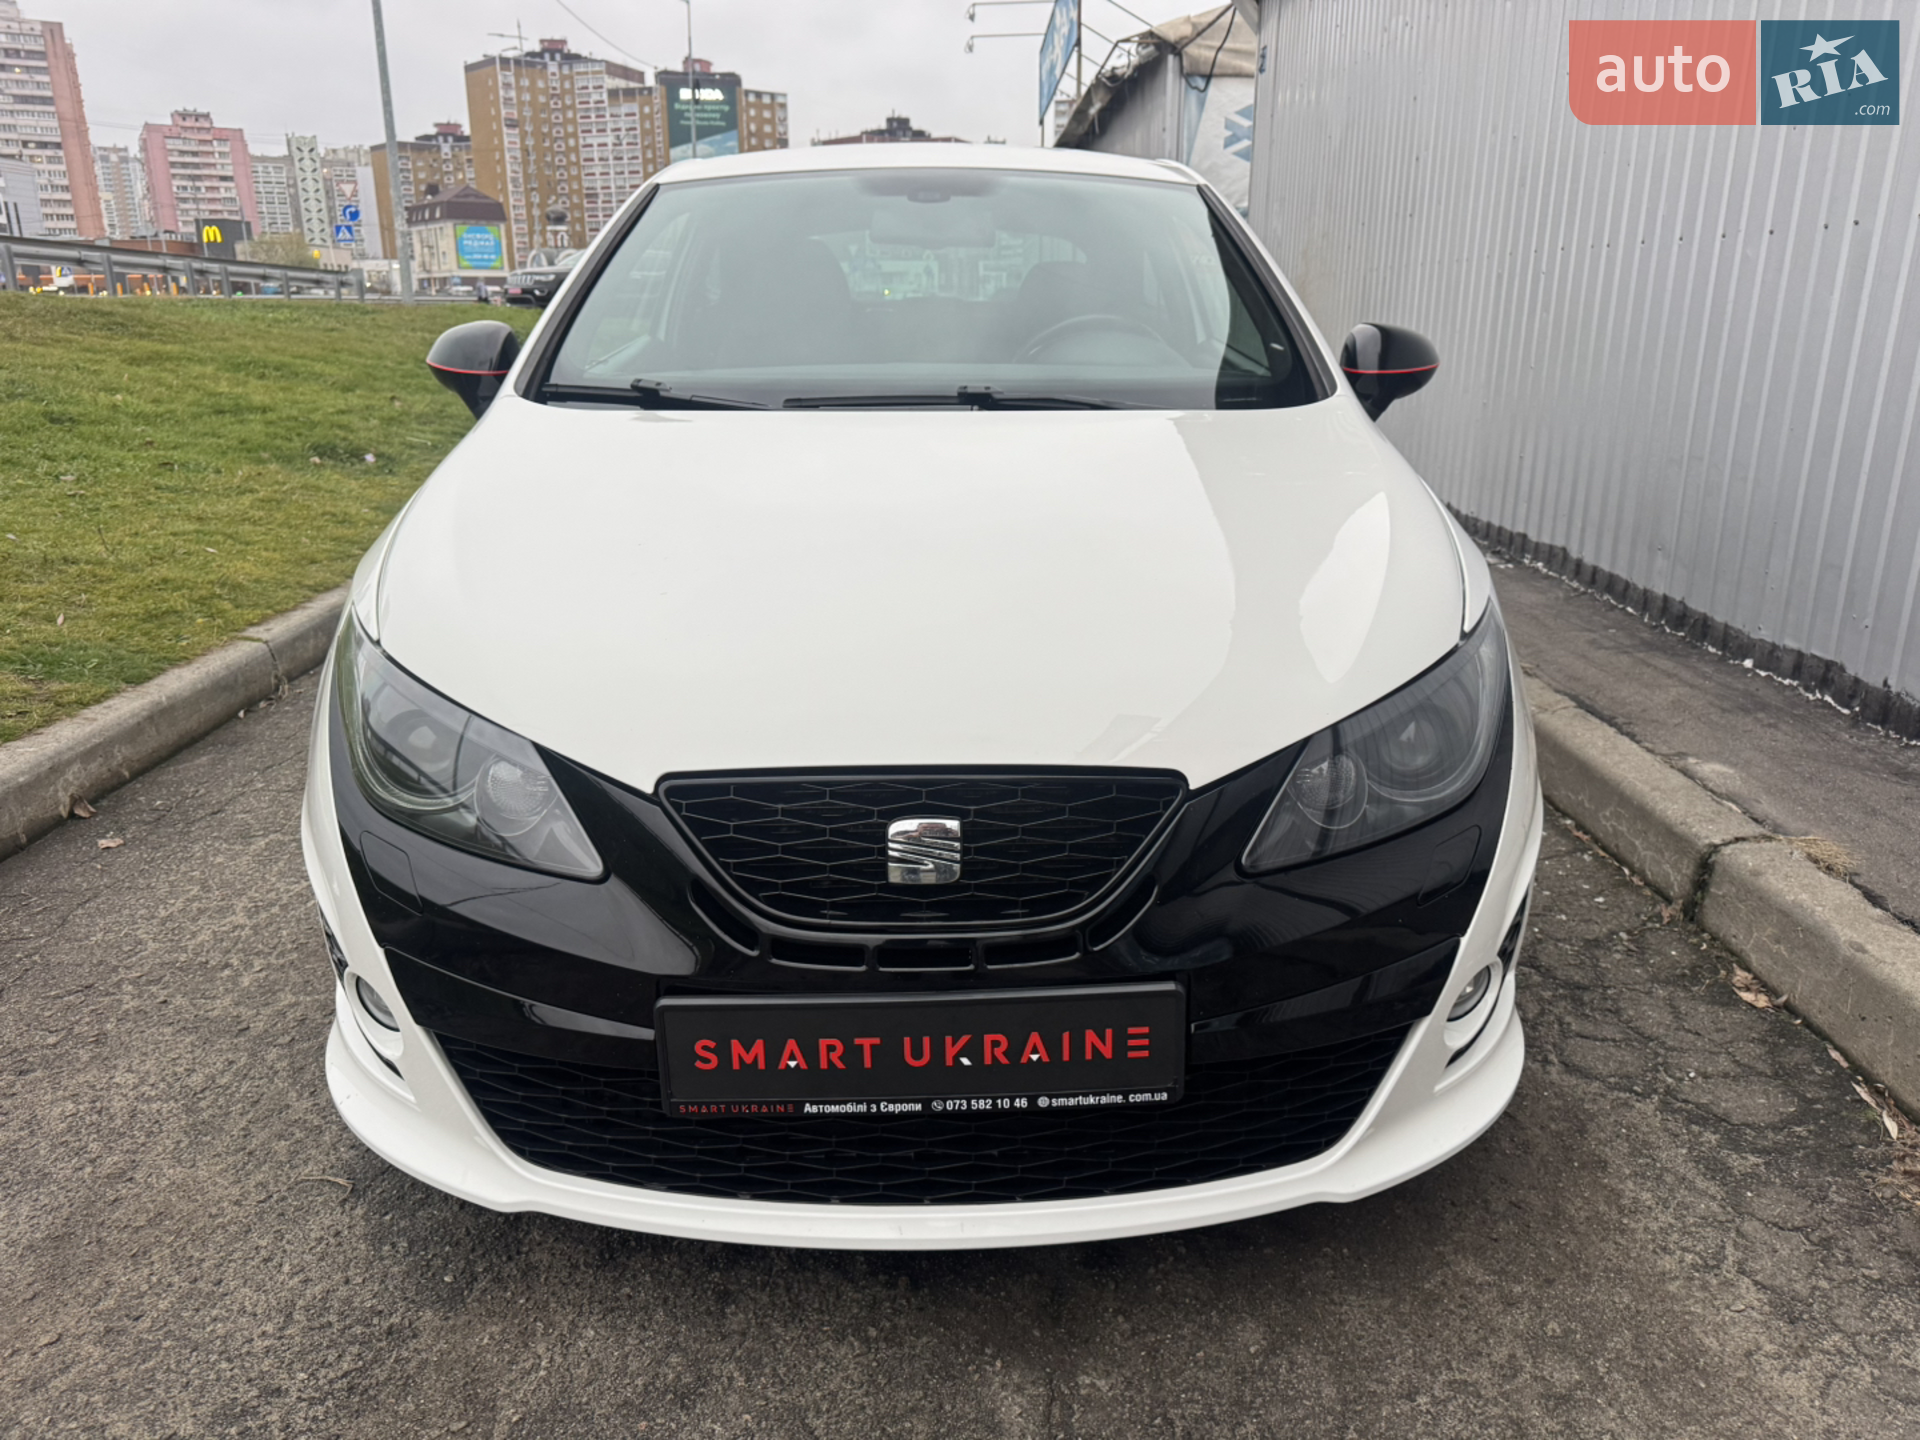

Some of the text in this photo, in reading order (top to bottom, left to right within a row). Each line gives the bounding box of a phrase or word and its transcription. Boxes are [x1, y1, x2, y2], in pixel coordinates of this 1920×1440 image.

[695, 1026, 1151, 1070] SMART UKRAINE
[679, 1104, 727, 1115] SMART
[731, 1103, 796, 1114] UKRAINE
[803, 1102, 868, 1114] Автомобілі
[870, 1103, 877, 1113] з
[879, 1101, 922, 1115] Європи
[945, 1099, 968, 1111] 073
[970, 1098, 993, 1110] 582
[996, 1097, 1011, 1109] 10
[1013, 1097, 1028, 1109] 46
